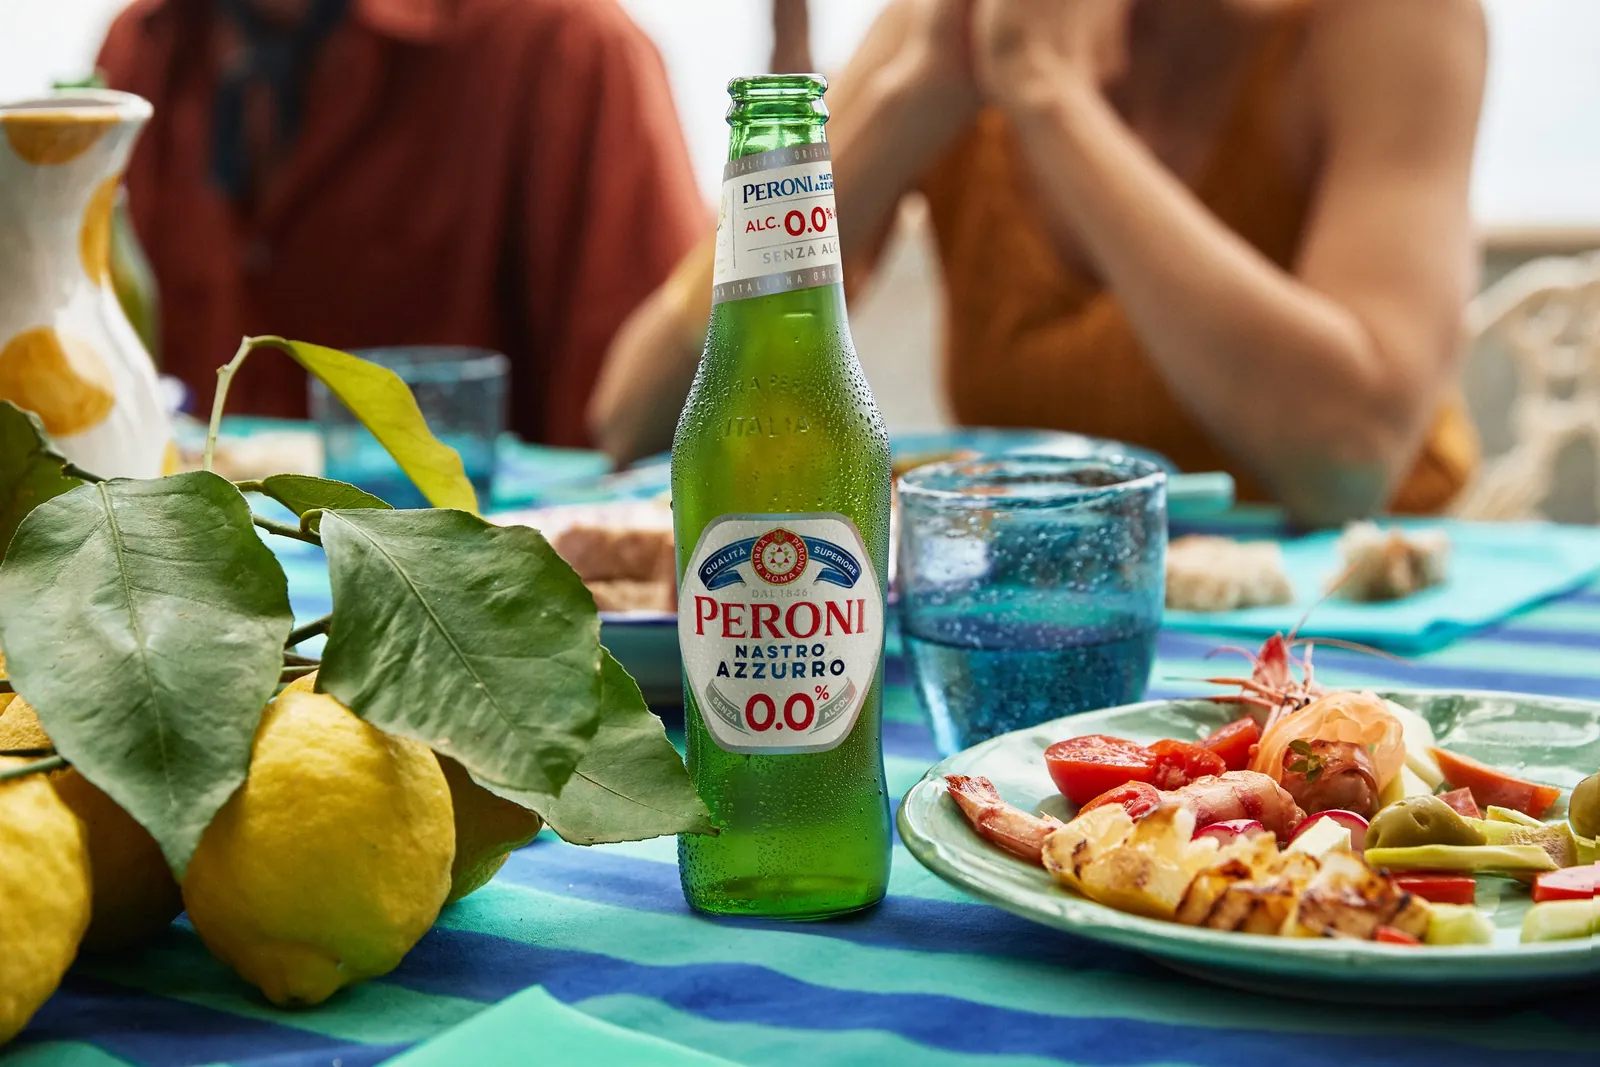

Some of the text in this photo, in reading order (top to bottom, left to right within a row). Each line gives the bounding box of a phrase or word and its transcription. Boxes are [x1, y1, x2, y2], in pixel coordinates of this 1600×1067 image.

[743, 176, 813, 204] PERONI
[745, 216, 781, 233] ALC.
[784, 206, 834, 237] 0.0%
[763, 242, 837, 264] SENZA ALC
[725, 416, 809, 437] ITALIA
[705, 546, 858, 576] QUALITÀ SUPERIORE
[754, 539, 768, 570] BIRRA
[765, 572, 795, 582] ROMA
[752, 588, 808, 598] DAL 1846
[694, 595, 867, 639] PERONI
[735, 643, 825, 659] NASTRO
[716, 659, 846, 679] AZZURRO
[712, 694, 850, 722] SENZA ALCOL
[745, 685, 830, 732] 0.0%
